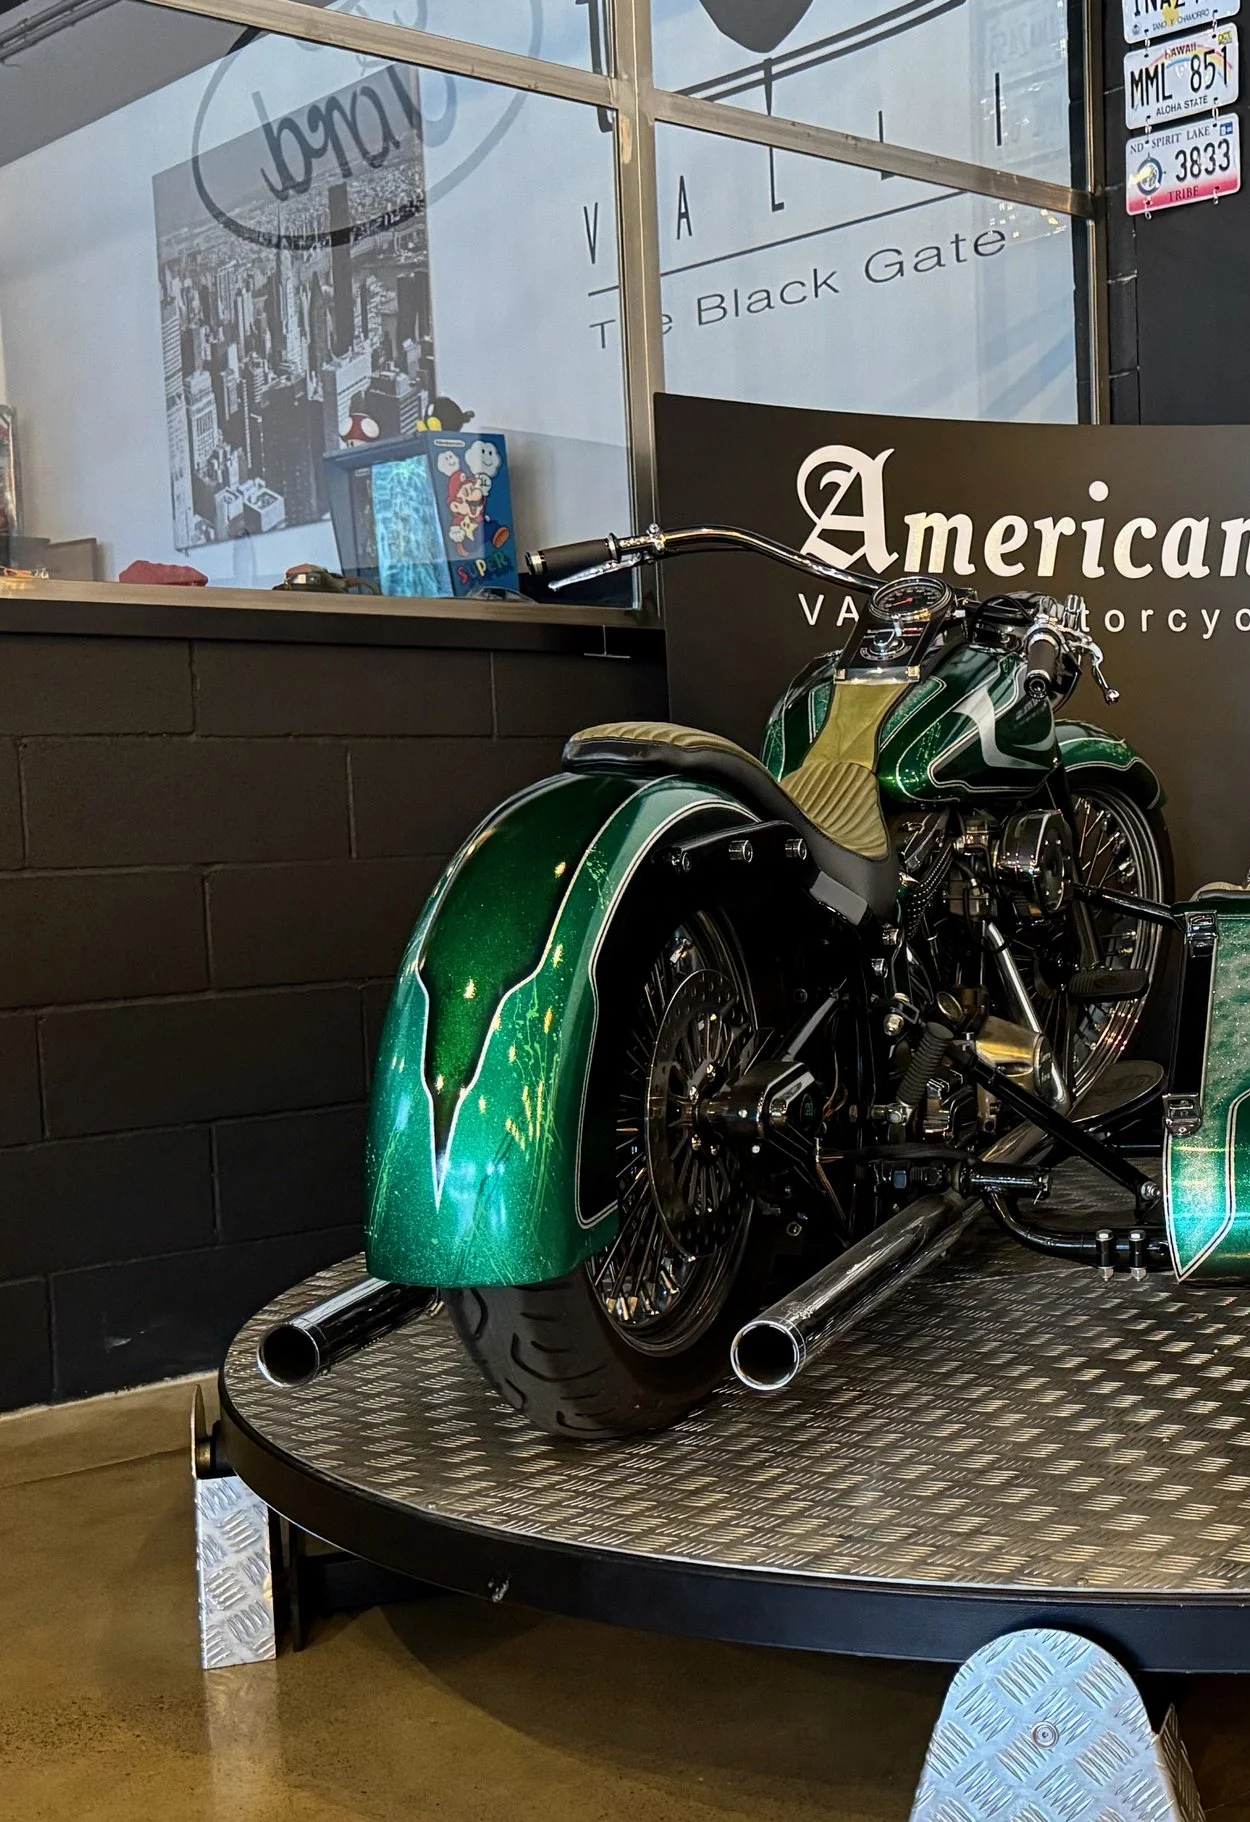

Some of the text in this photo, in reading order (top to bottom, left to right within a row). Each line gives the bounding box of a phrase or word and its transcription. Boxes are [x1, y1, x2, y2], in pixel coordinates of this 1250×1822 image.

[1164, 42, 1197, 60] HAWAII
[1130, 46, 1228, 110] MML 851
[1156, 95, 1209, 117] ALOHA STATE
[1130, 125, 1211, 155] ND SPIRIT LAKE
[1175, 138, 1231, 183] 3833
[1168, 186, 1200, 203] TRIBE
[589, 230, 1006, 348] Te Black Gate
